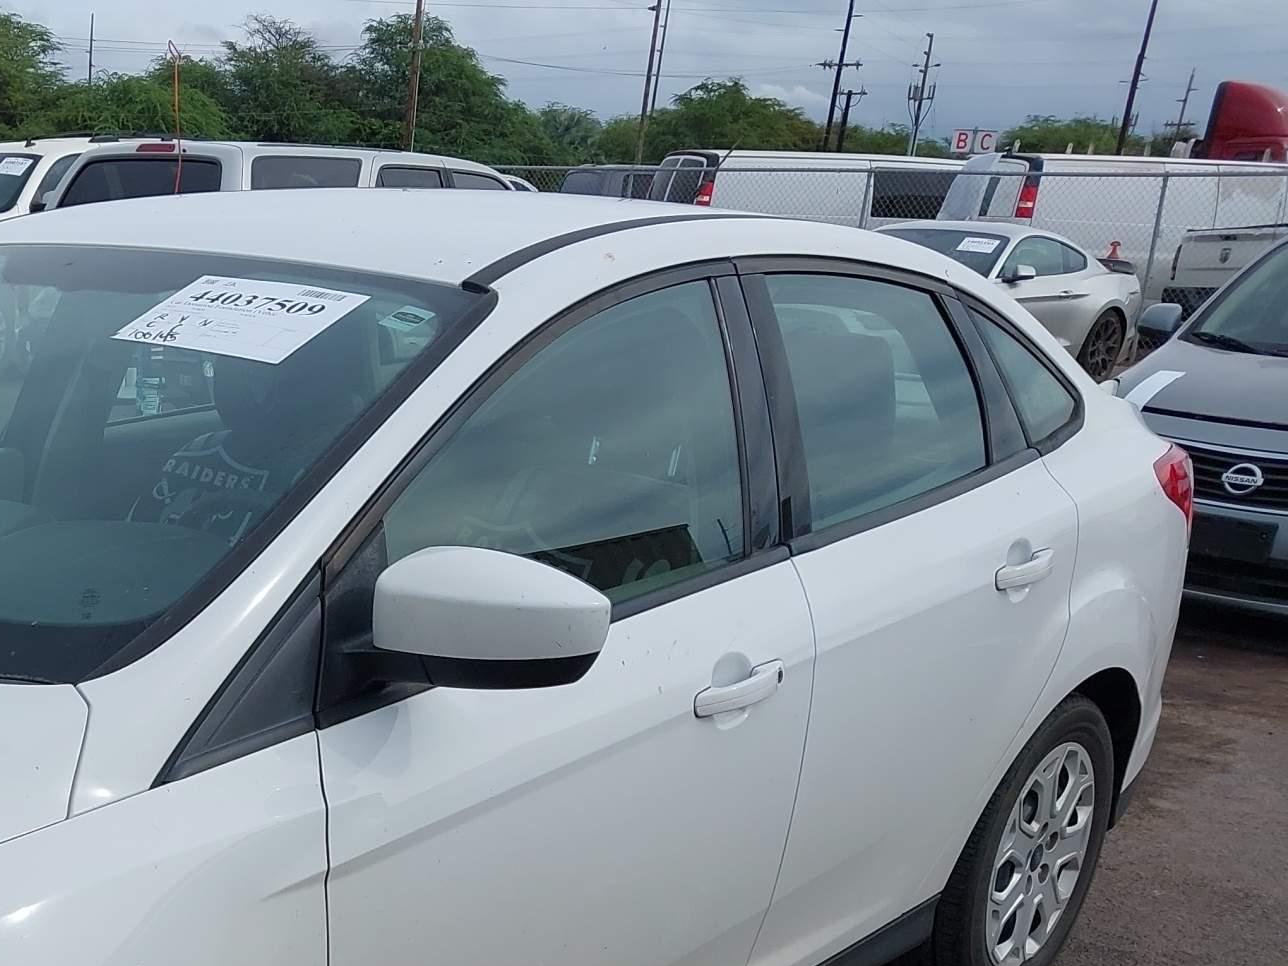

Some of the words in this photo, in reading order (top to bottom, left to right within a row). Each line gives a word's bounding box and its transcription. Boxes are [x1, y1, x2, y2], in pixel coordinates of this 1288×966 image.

[956, 132, 969, 149] B
[980, 134, 993, 151] C
[189, 290, 326, 316] 44037509
[162, 459, 250, 489] RAIDERS
[1225, 475, 1258, 484] NISSAN
